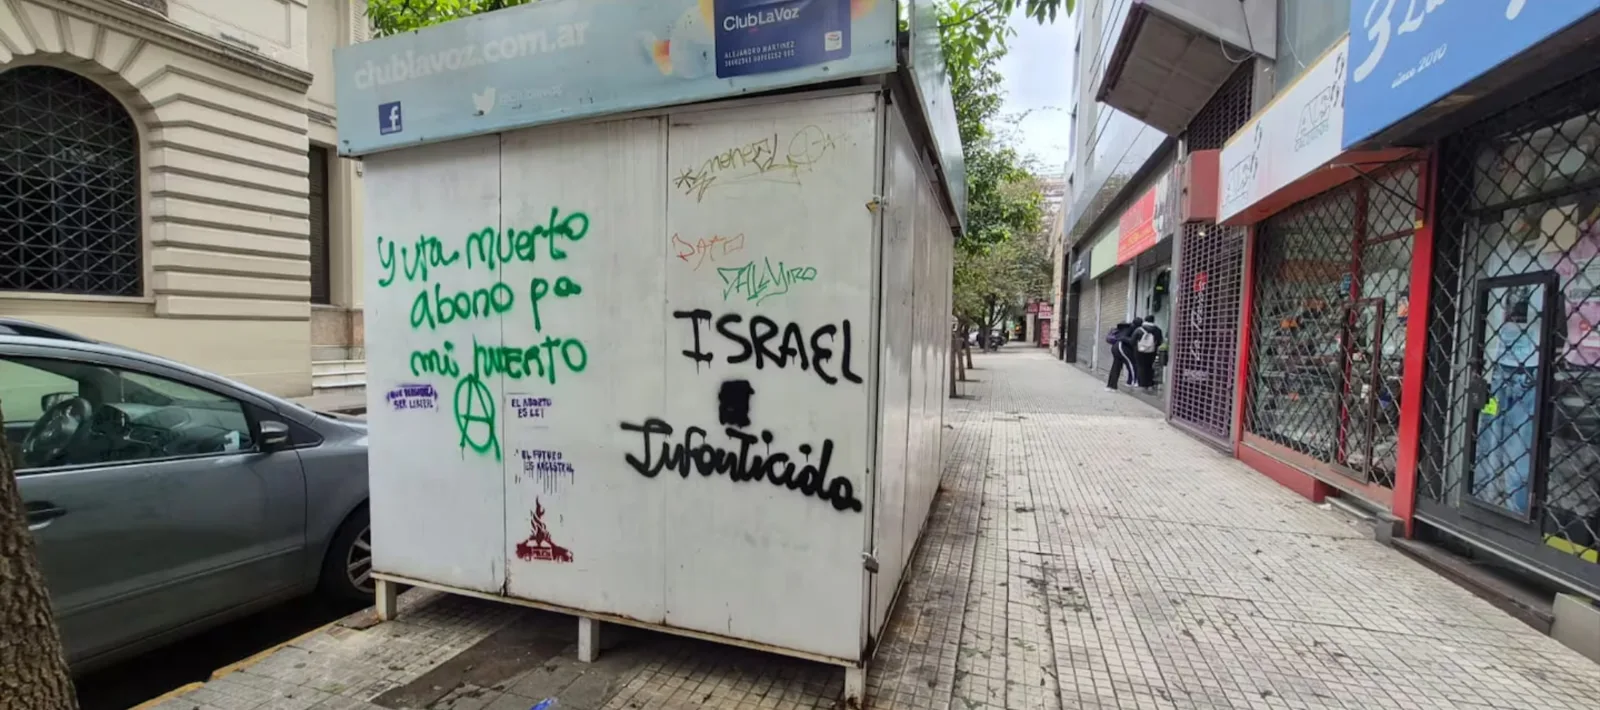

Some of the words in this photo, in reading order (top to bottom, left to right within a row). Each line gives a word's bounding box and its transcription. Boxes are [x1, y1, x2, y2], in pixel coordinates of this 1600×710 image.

[723, 7, 800, 31] ClubLaVoz
[354, 20, 589, 91] clublavoz.com.ar
[1417, 43, 1447, 73] 2010
[673, 308, 864, 385] ISRAEL
